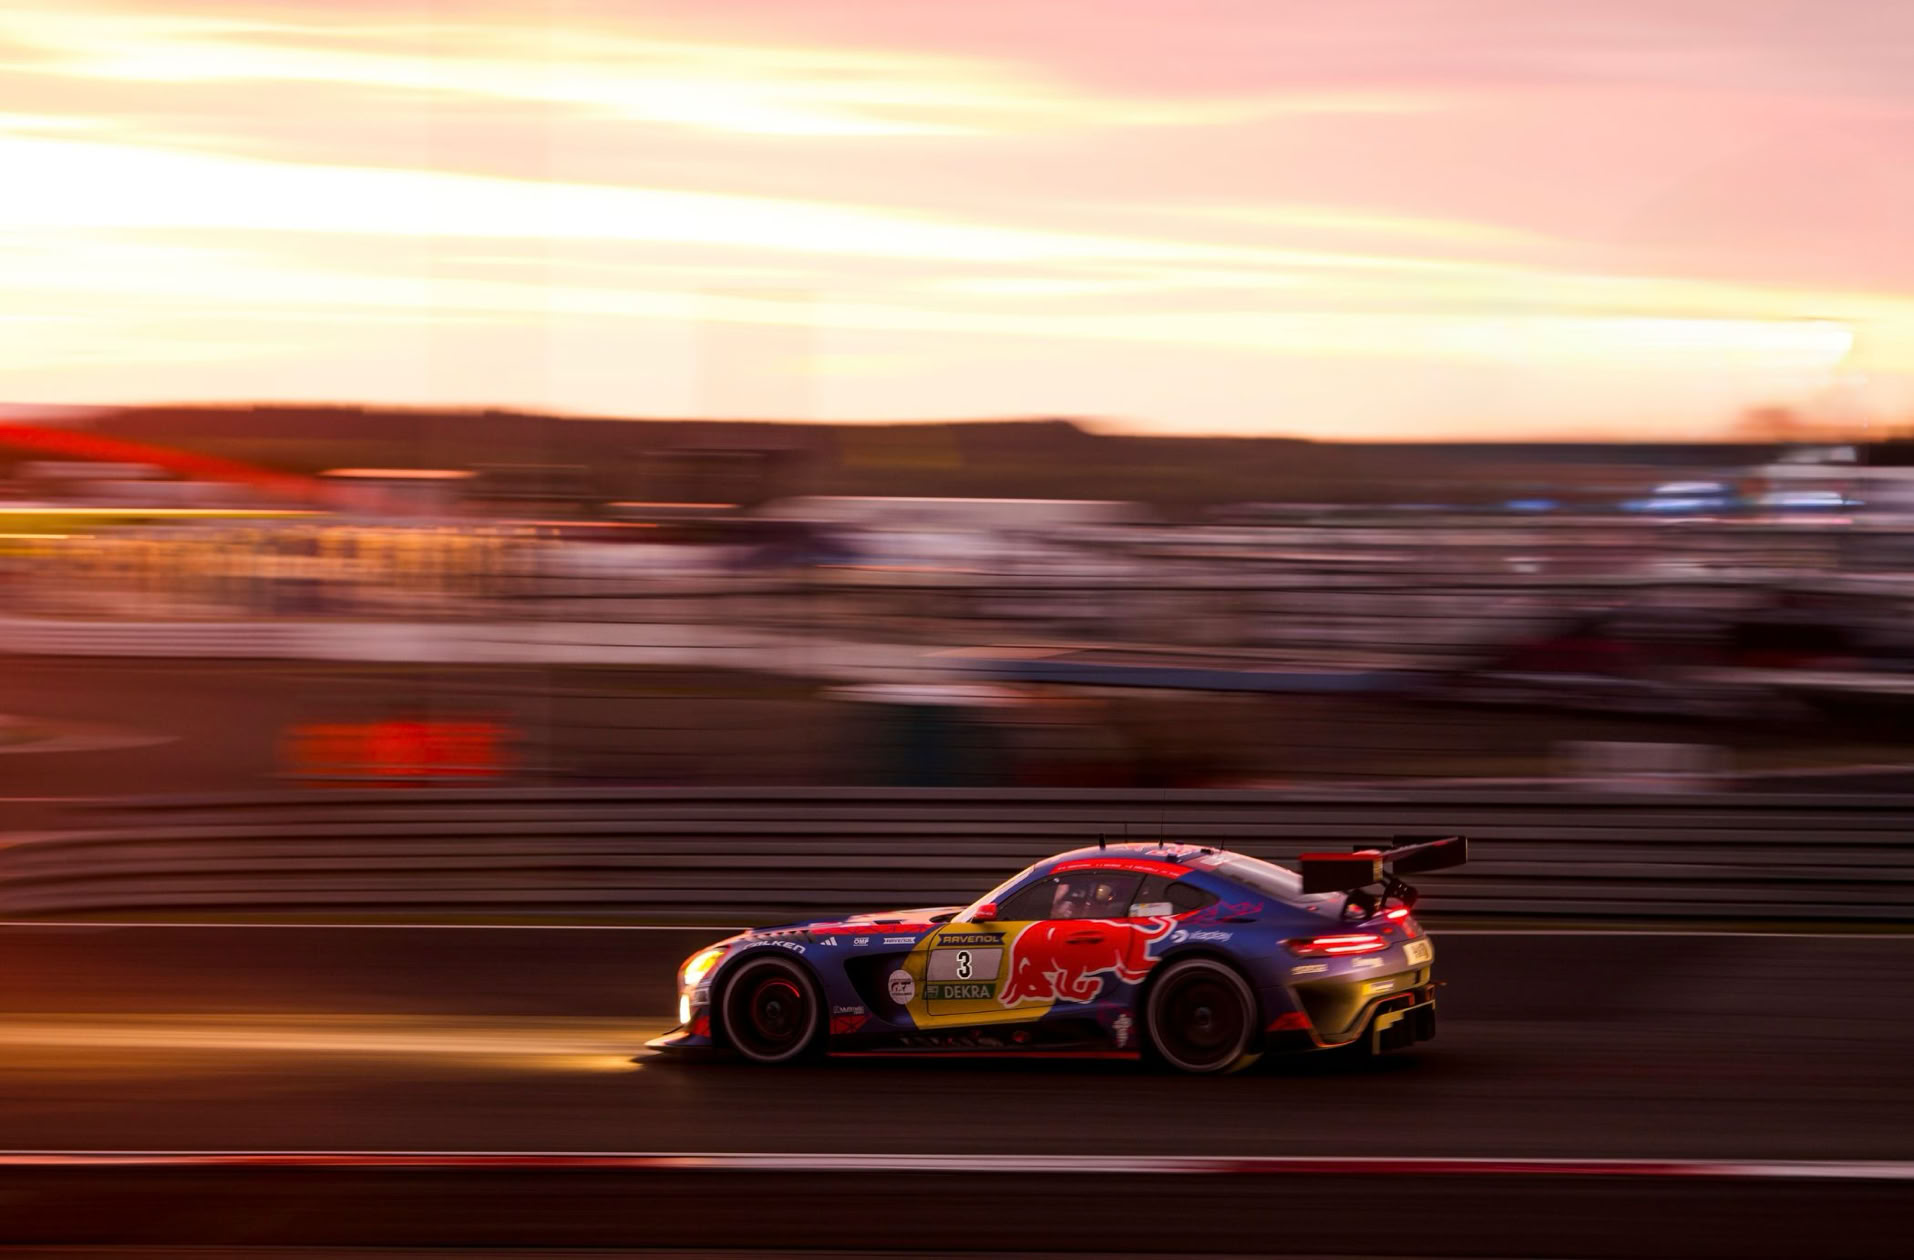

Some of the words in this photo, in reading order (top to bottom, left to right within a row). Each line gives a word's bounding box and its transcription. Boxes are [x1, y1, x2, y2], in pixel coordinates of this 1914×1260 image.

[943, 935, 1000, 944] RAVENOL
[743, 940, 806, 954] FALKEN
[957, 950, 972, 979] 3
[944, 986, 990, 998] DEKRA
